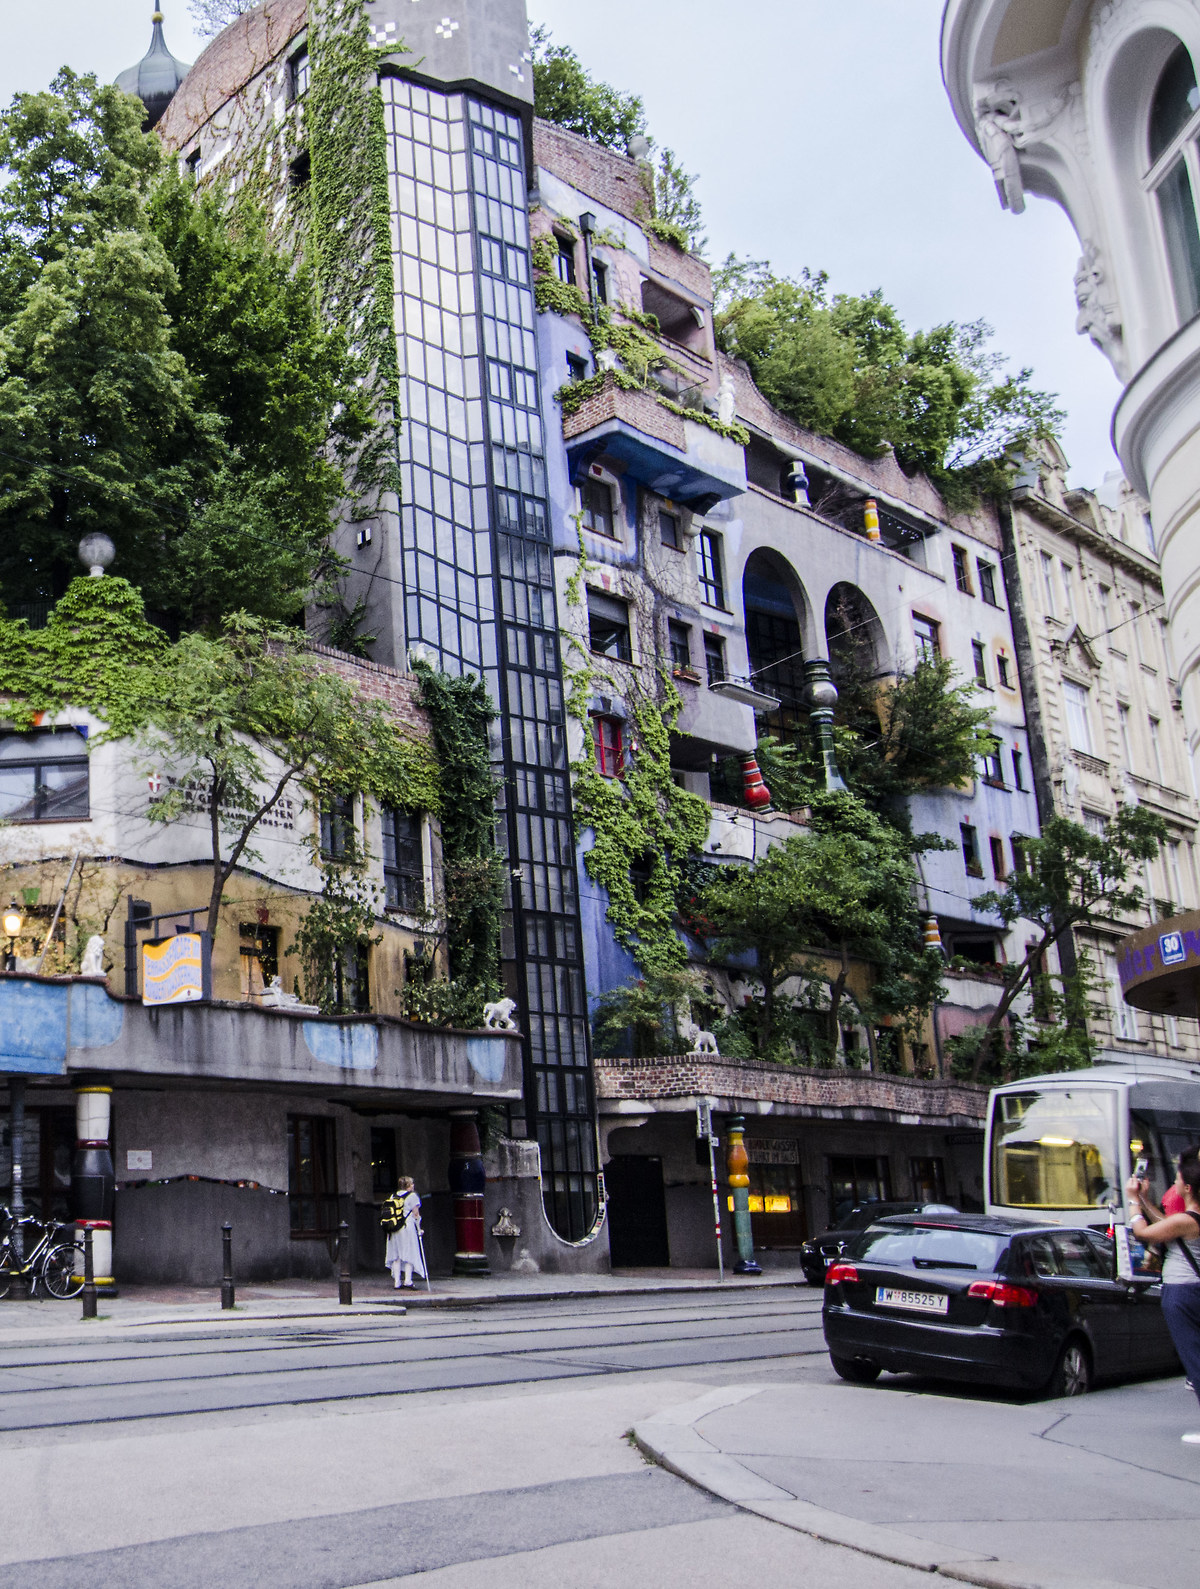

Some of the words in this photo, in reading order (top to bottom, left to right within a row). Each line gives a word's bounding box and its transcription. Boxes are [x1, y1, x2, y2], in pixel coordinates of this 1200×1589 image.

[1163, 936, 1179, 953] 30
[885, 1290, 893, 1301] W
[901, 1292, 935, 1306] 85525
[937, 1296, 944, 1307] Y
